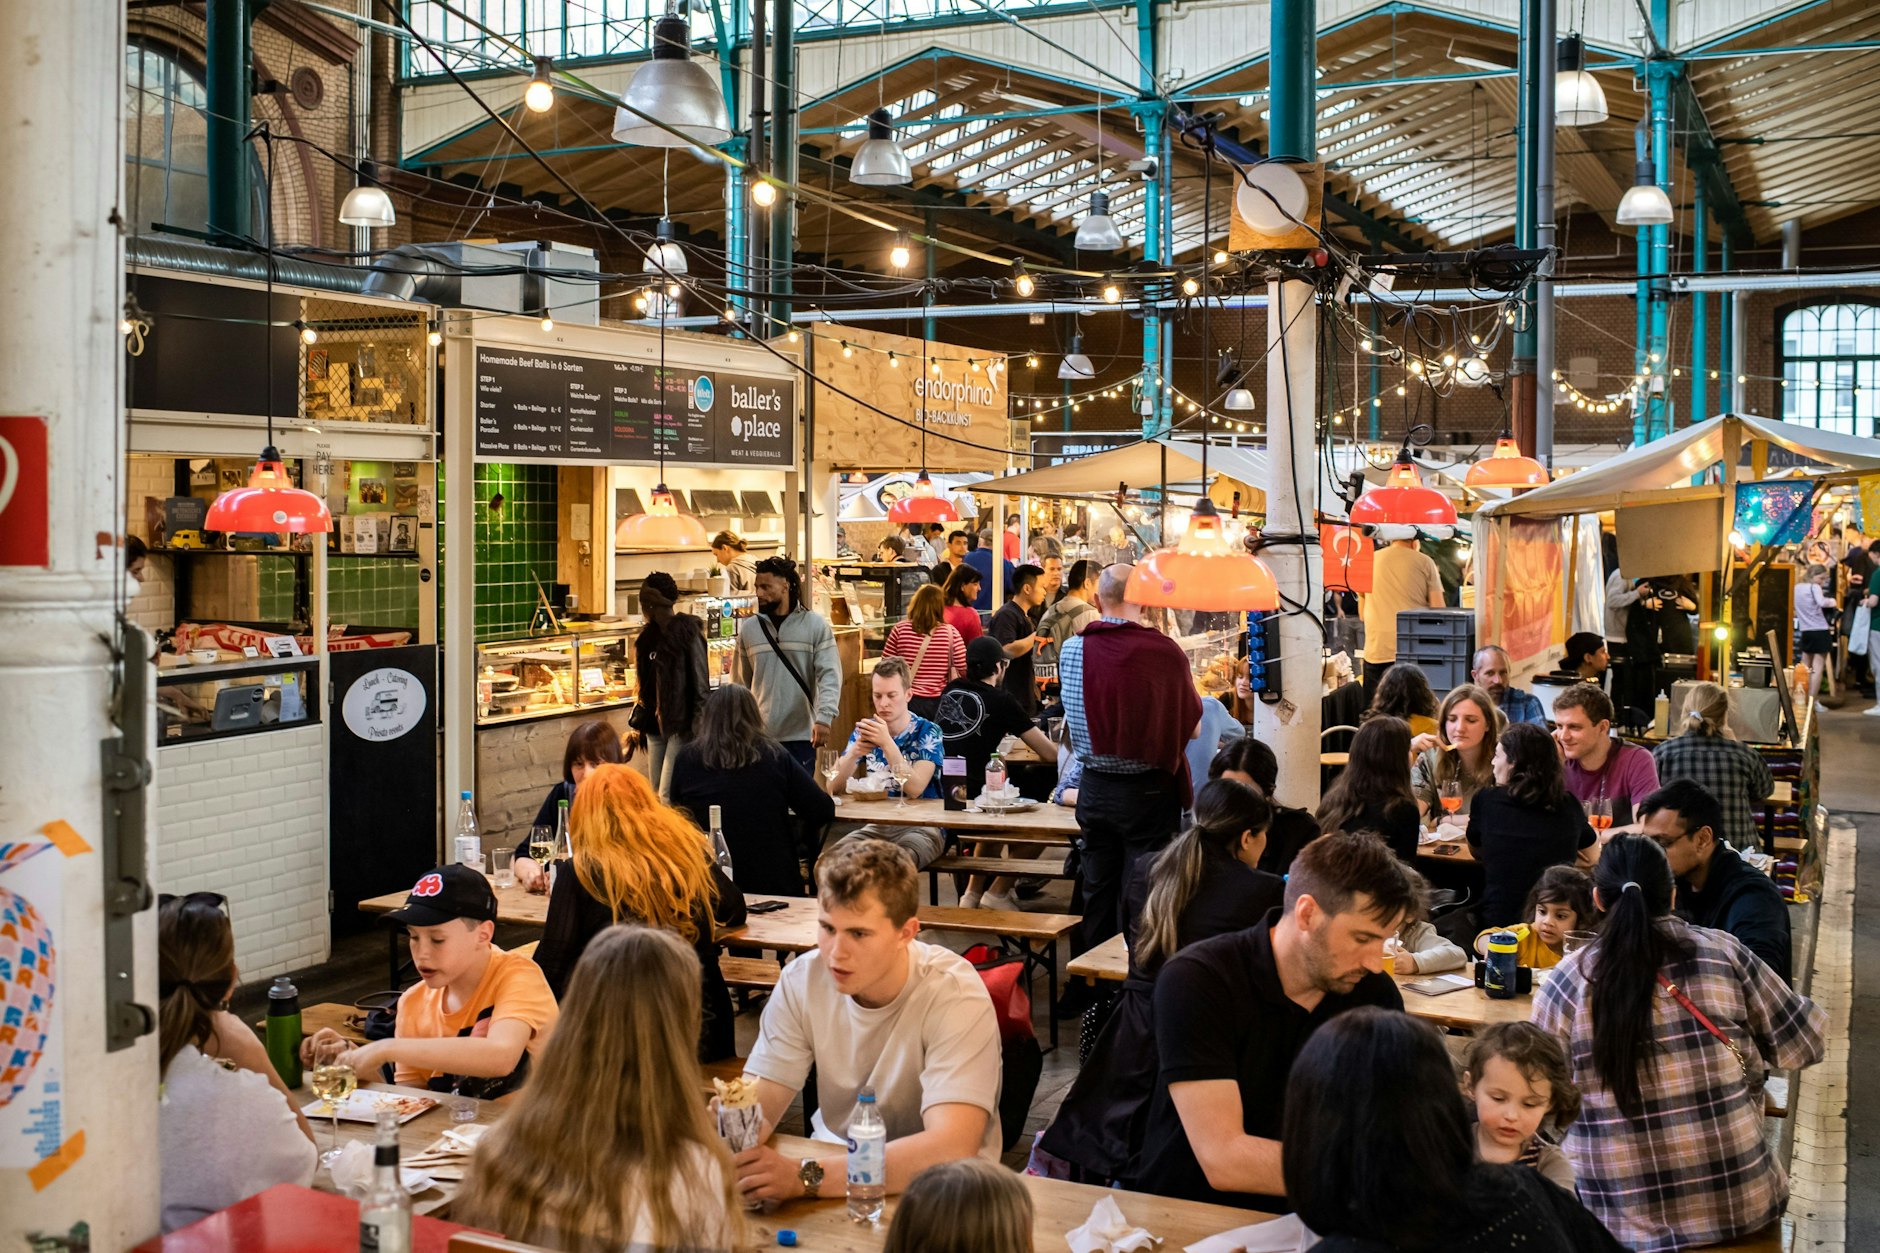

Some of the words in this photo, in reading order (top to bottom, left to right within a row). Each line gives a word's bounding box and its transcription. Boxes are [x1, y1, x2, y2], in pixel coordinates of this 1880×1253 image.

[480, 353, 518, 366] Homemade
[518, 357, 534, 368] Beef
[534, 359, 550, 369] Balls
[550, 360, 557, 370] in
[558, 362, 562, 370] 6
[562, 362, 584, 372] Sorten
[730, 384, 781, 411] baller's
[915, 368, 992, 411] endorphina
[744, 414, 780, 442] place
[316, 452, 331, 461] PAY
[750, 450, 781, 458] VEGGIEBALLS
[313, 465, 335, 475] HERE
[363, 674, 379, 690] Lunch
[387, 672, 408, 689] Catering
[368, 726, 387, 739] Private
[389, 724, 404, 735] events
